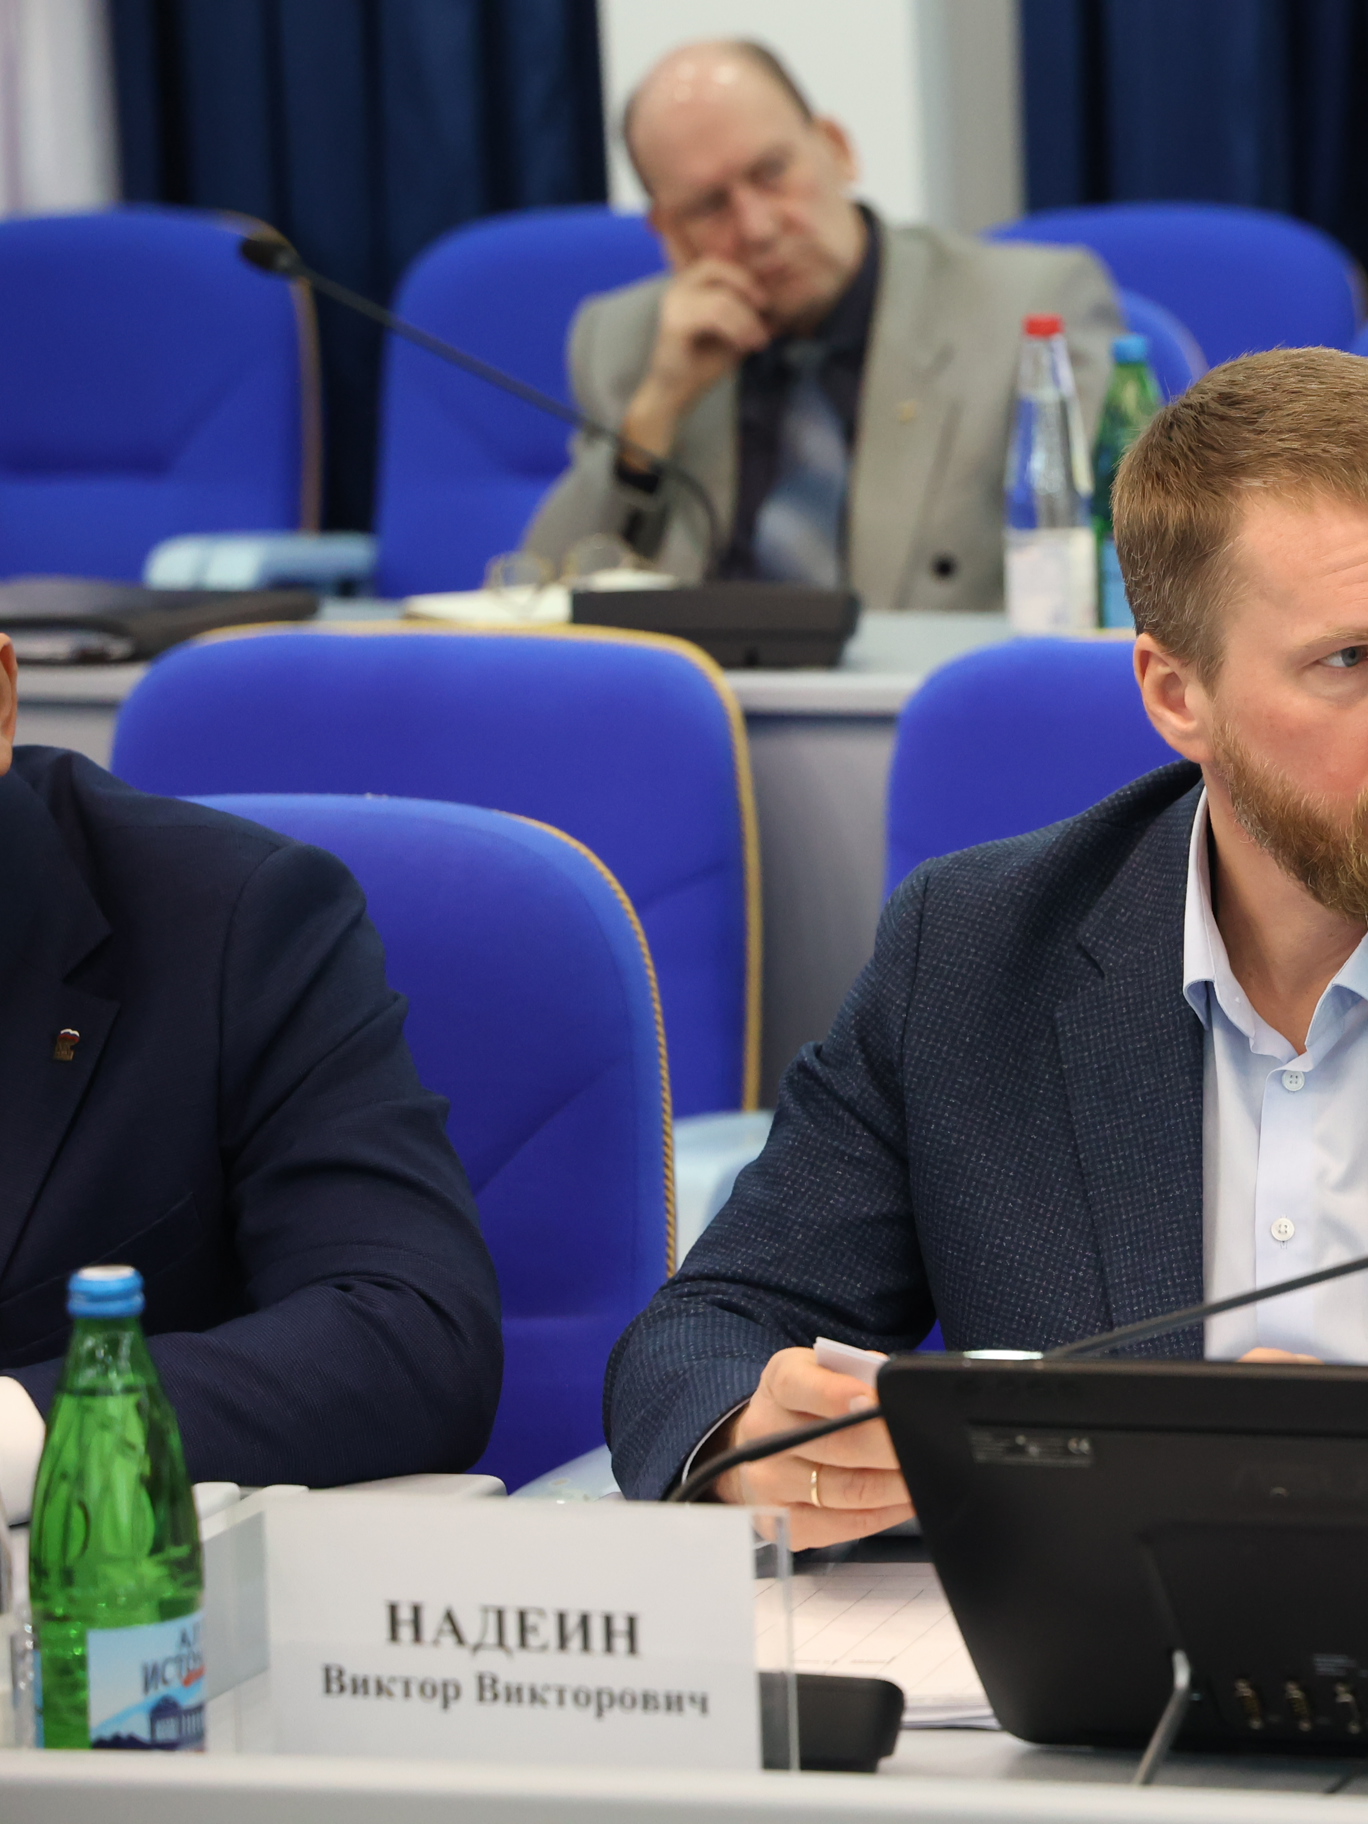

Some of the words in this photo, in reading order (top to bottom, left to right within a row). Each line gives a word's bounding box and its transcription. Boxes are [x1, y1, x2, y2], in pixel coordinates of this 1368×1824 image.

[386, 1601, 642, 1659] НАДЕИН
[323, 1664, 462, 1713] Виктор
[476, 1671, 709, 1721] Викторович
